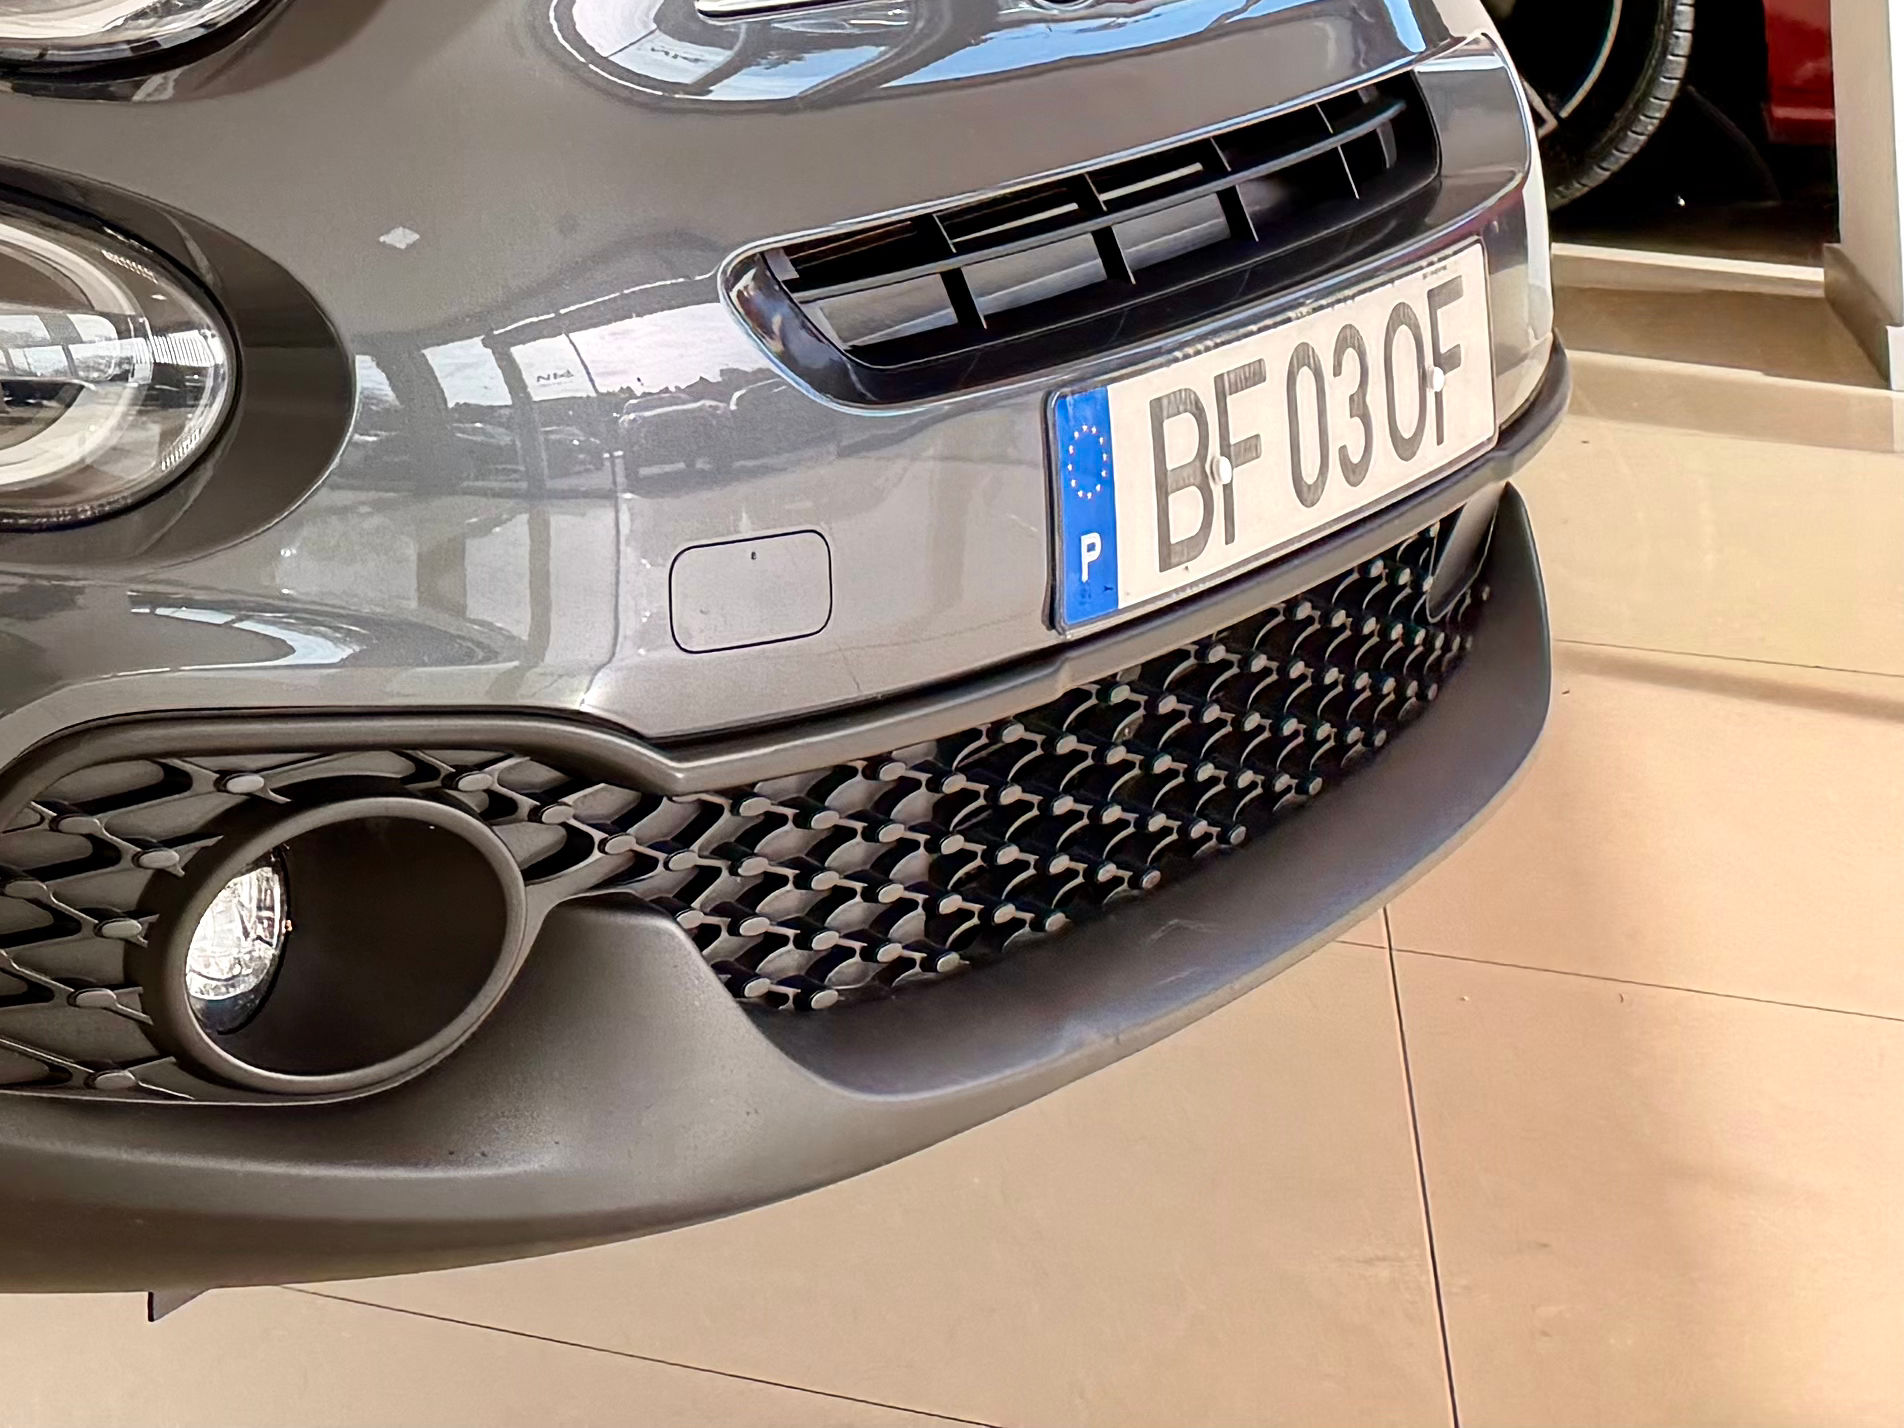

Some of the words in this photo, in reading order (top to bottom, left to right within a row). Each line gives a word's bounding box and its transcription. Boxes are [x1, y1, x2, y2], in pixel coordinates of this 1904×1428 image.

[1149, 357, 1267, 573] BF
[1286, 323, 1374, 508] 03
[1384, 275, 1464, 463] OF
[1080, 531, 1102, 583] P
